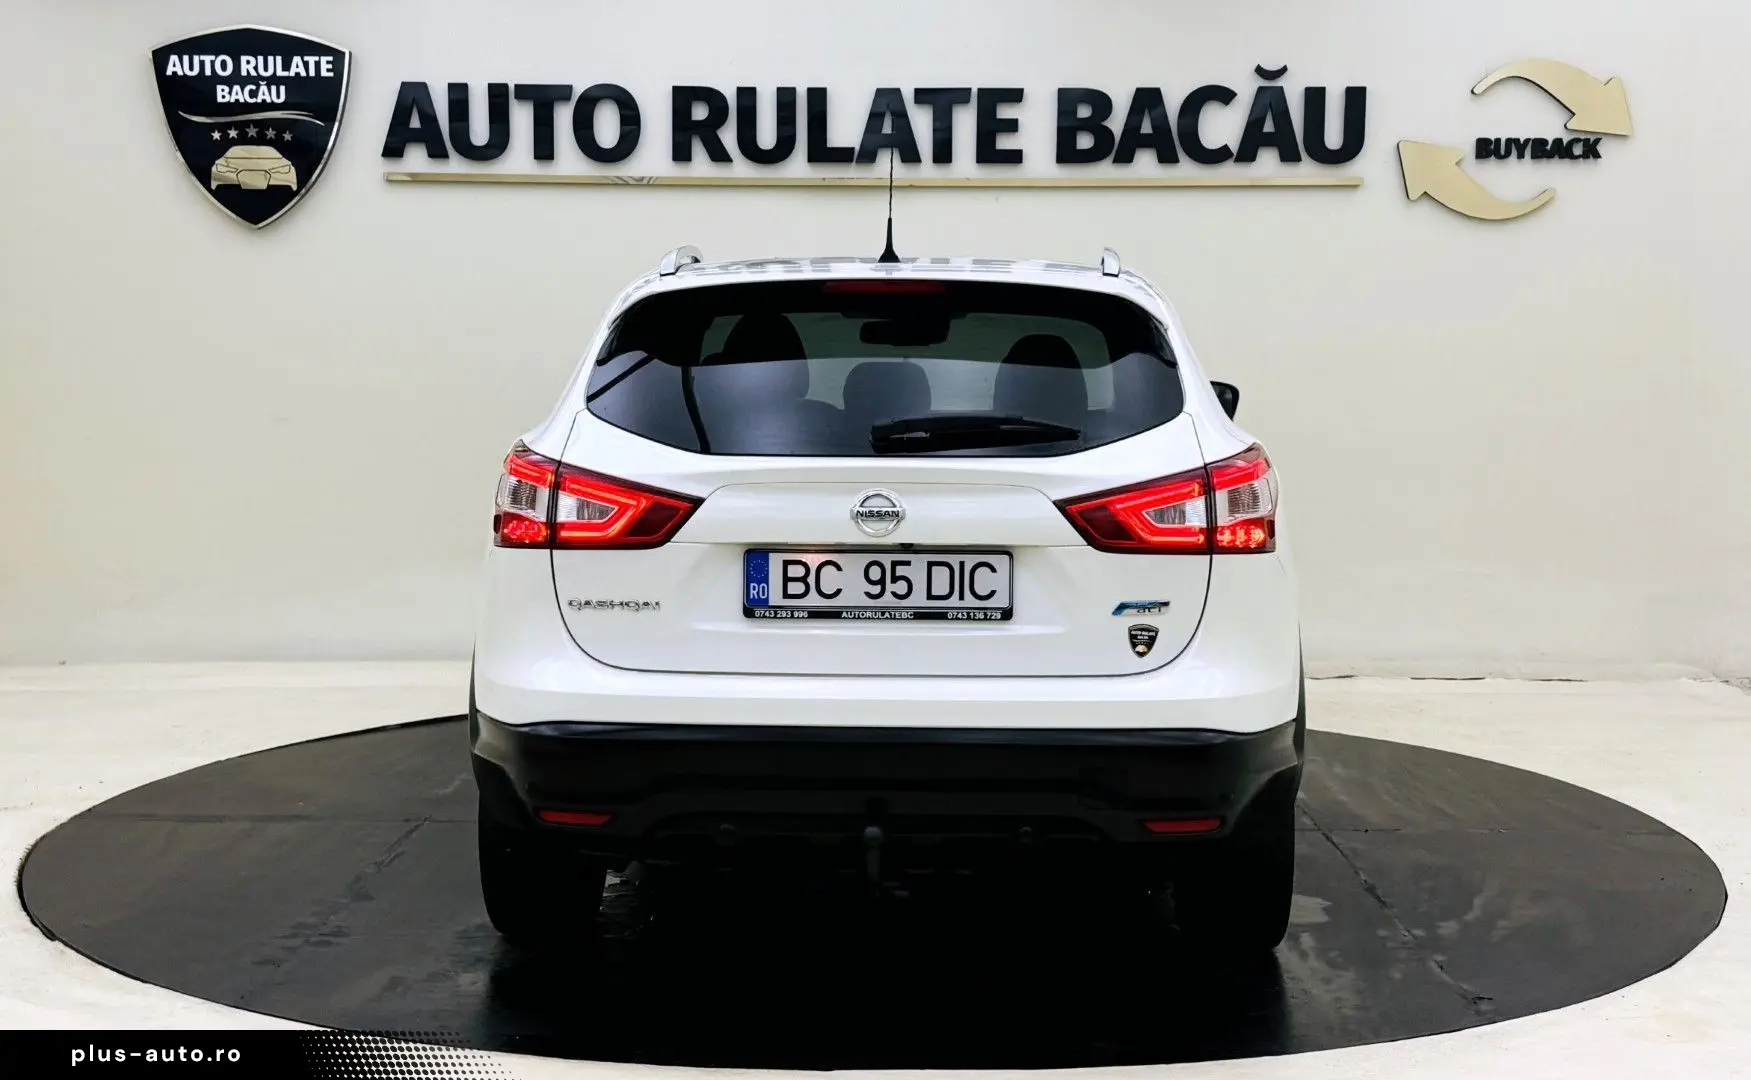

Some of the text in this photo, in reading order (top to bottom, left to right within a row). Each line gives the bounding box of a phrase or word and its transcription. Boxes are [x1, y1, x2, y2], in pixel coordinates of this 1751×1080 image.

[166, 54, 334, 78] AUTO RULATE
[216, 80, 286, 104] BACĂU
[382, 64, 1367, 166] AUTO RULATE BACĂU
[1475, 137, 1603, 160] BUYBACK
[856, 510, 900, 518] NISSAN
[750, 583, 768, 599] RO
[782, 559, 998, 601] BC 95 DIC
[754, 610, 775, 618] 0743
[841, 611, 914, 619] AUTORULATEBC
